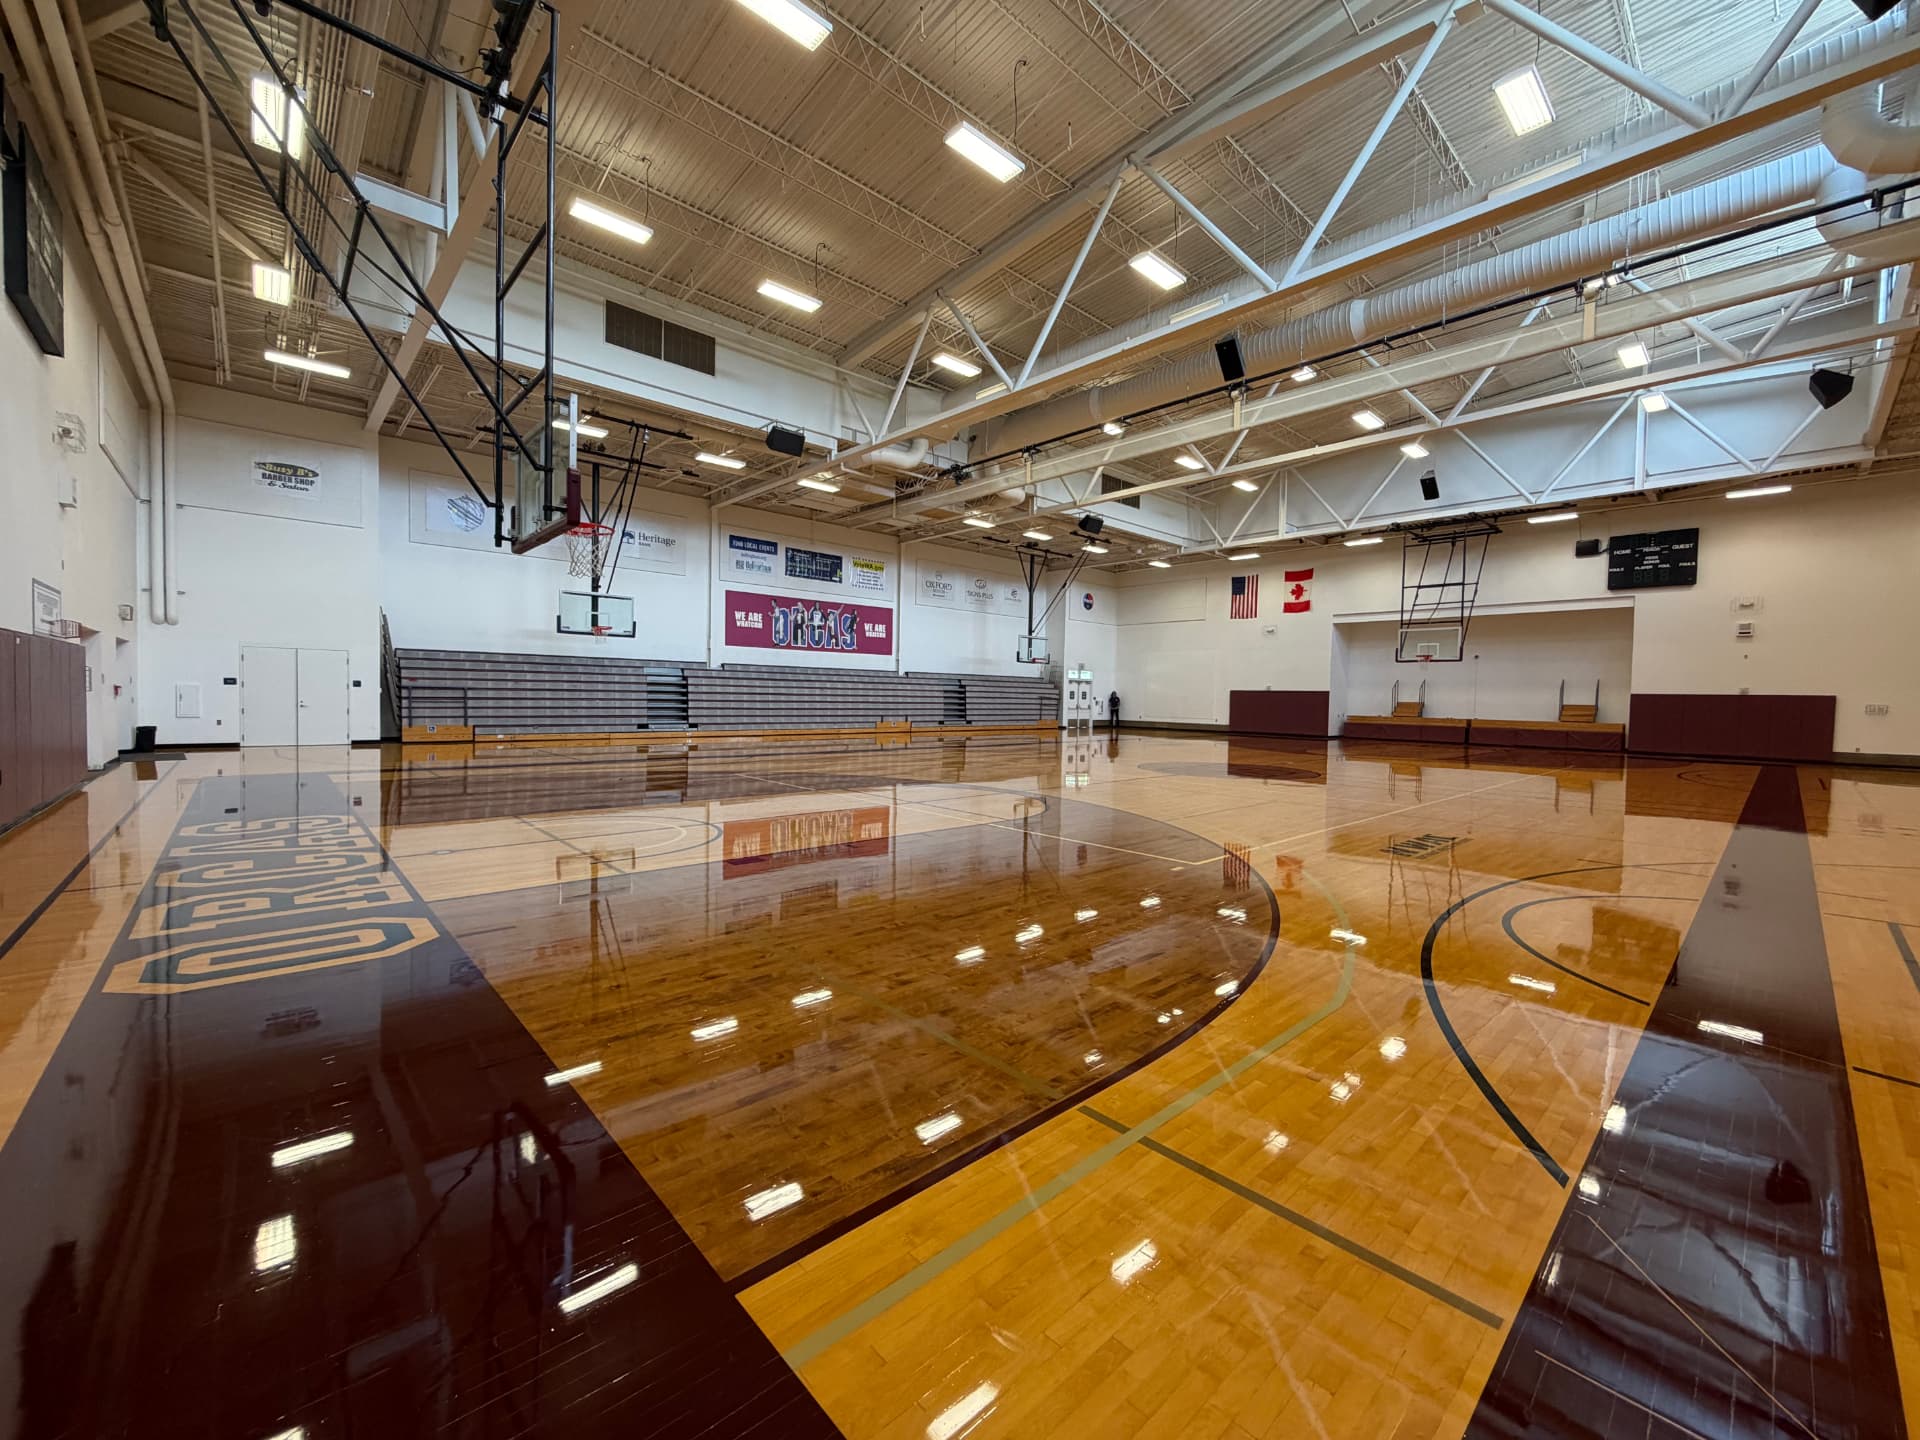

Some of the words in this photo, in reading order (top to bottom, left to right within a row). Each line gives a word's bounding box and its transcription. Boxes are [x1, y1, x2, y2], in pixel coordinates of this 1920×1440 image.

[265, 463, 293, 475] Busy
[296, 468, 313, 477] B's
[261, 472, 293, 483] BARBER
[294, 477, 315, 487] SHOP
[278, 482, 310, 491] Salon
[638, 531, 676, 547] Heritage
[925, 580, 953, 591] OXFORD
[734, 611, 747, 622] WE
[747, 613, 763, 623] ARE
[772, 606, 857, 649] ORCAS
[864, 623, 875, 632] WE
[874, 624, 887, 633] ARE
